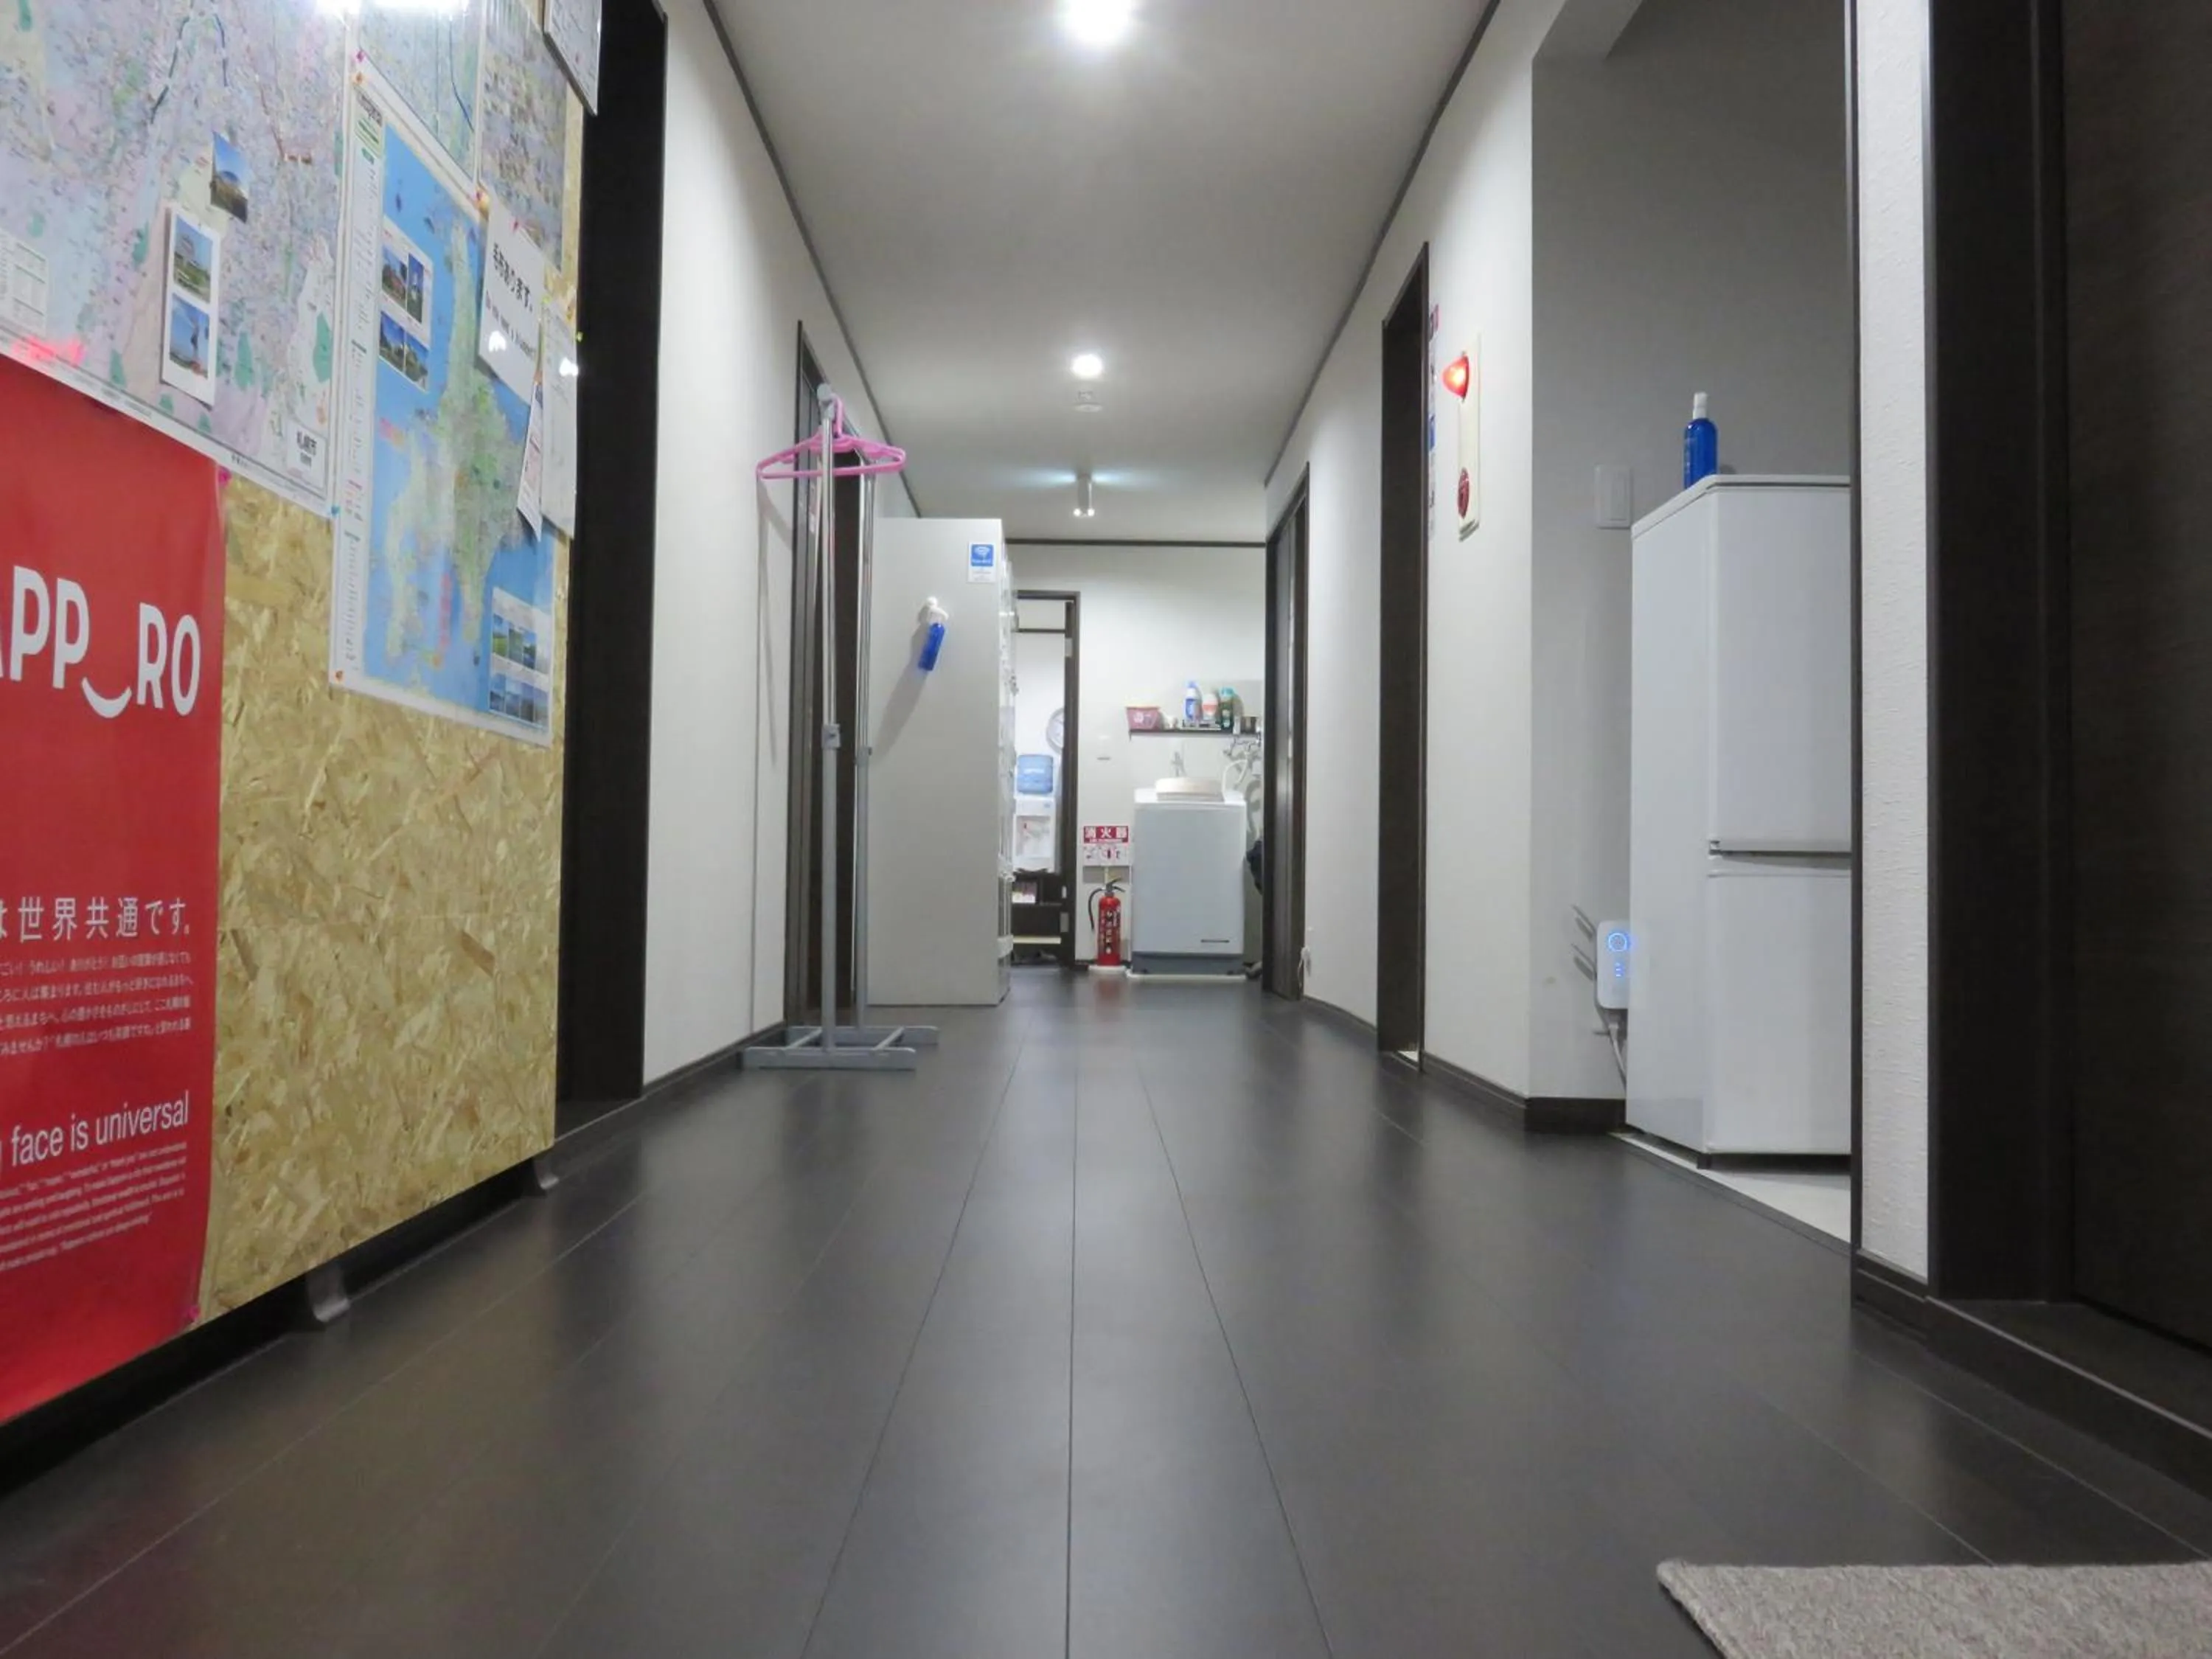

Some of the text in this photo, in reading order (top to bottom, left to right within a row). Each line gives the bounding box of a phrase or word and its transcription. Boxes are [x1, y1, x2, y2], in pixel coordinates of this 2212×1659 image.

[11, 1125, 64, 1167] face
[70, 1113, 89, 1152] is
[95, 1089, 189, 1146] universal
